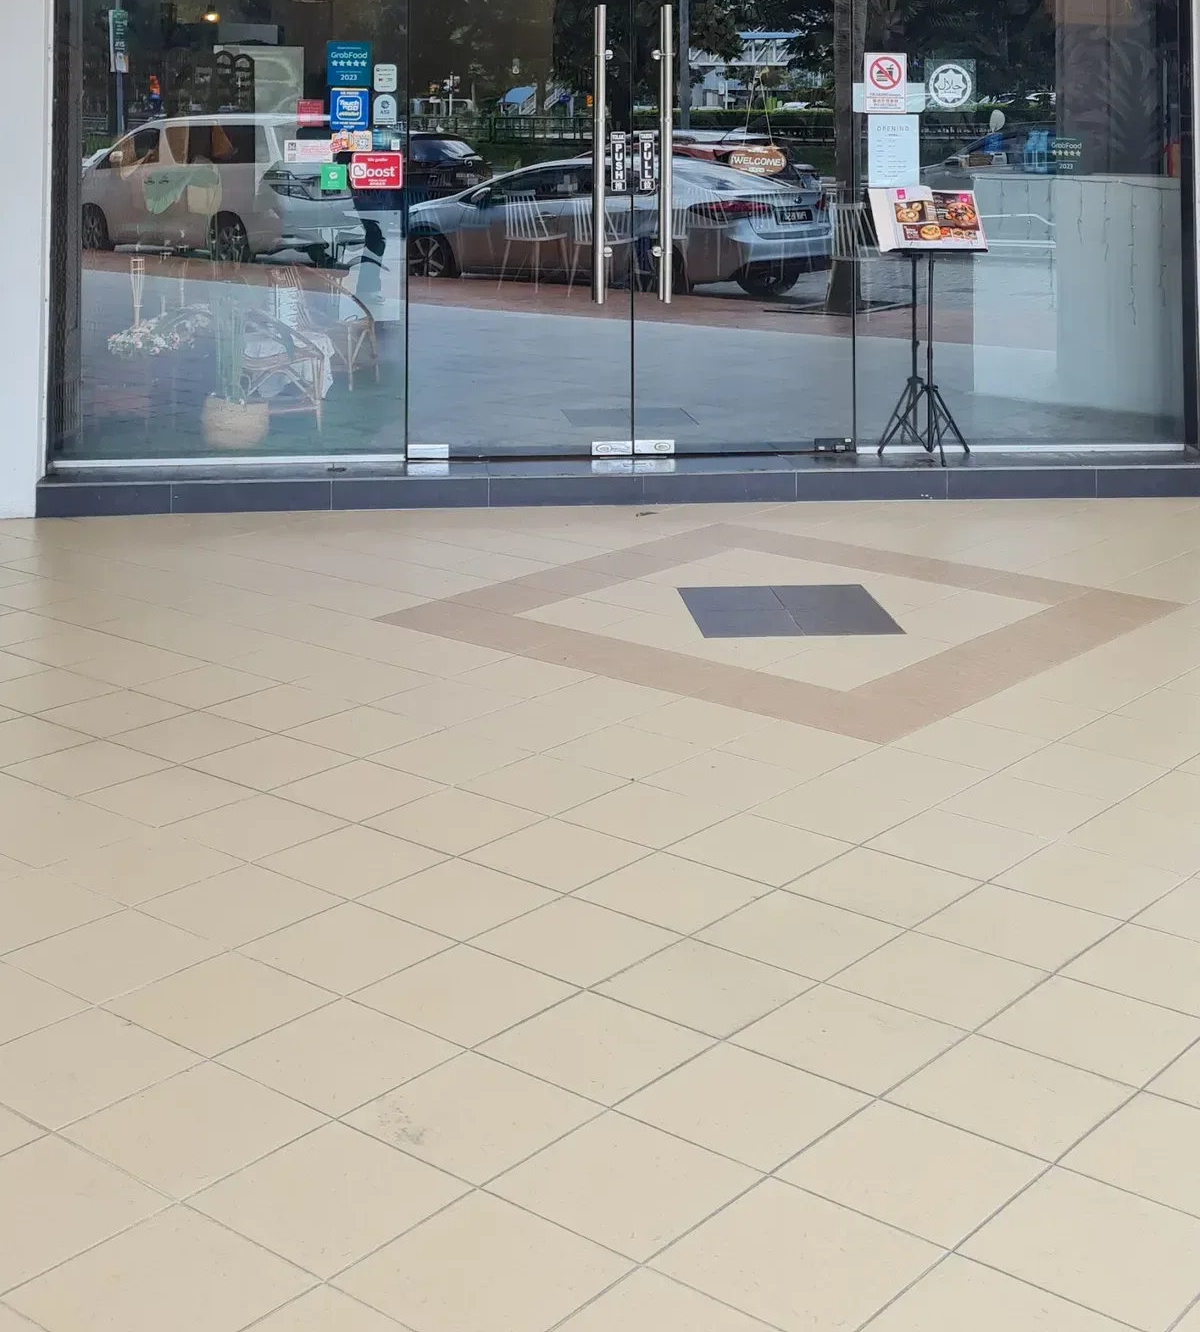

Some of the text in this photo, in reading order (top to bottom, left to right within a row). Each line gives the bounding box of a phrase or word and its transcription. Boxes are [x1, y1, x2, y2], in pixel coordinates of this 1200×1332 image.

[330, 51, 368, 59] GrabFood
[614, 143, 624, 180] PUSH
[643, 142, 652, 179] PULL
[733, 156, 781, 167] WELCOME
